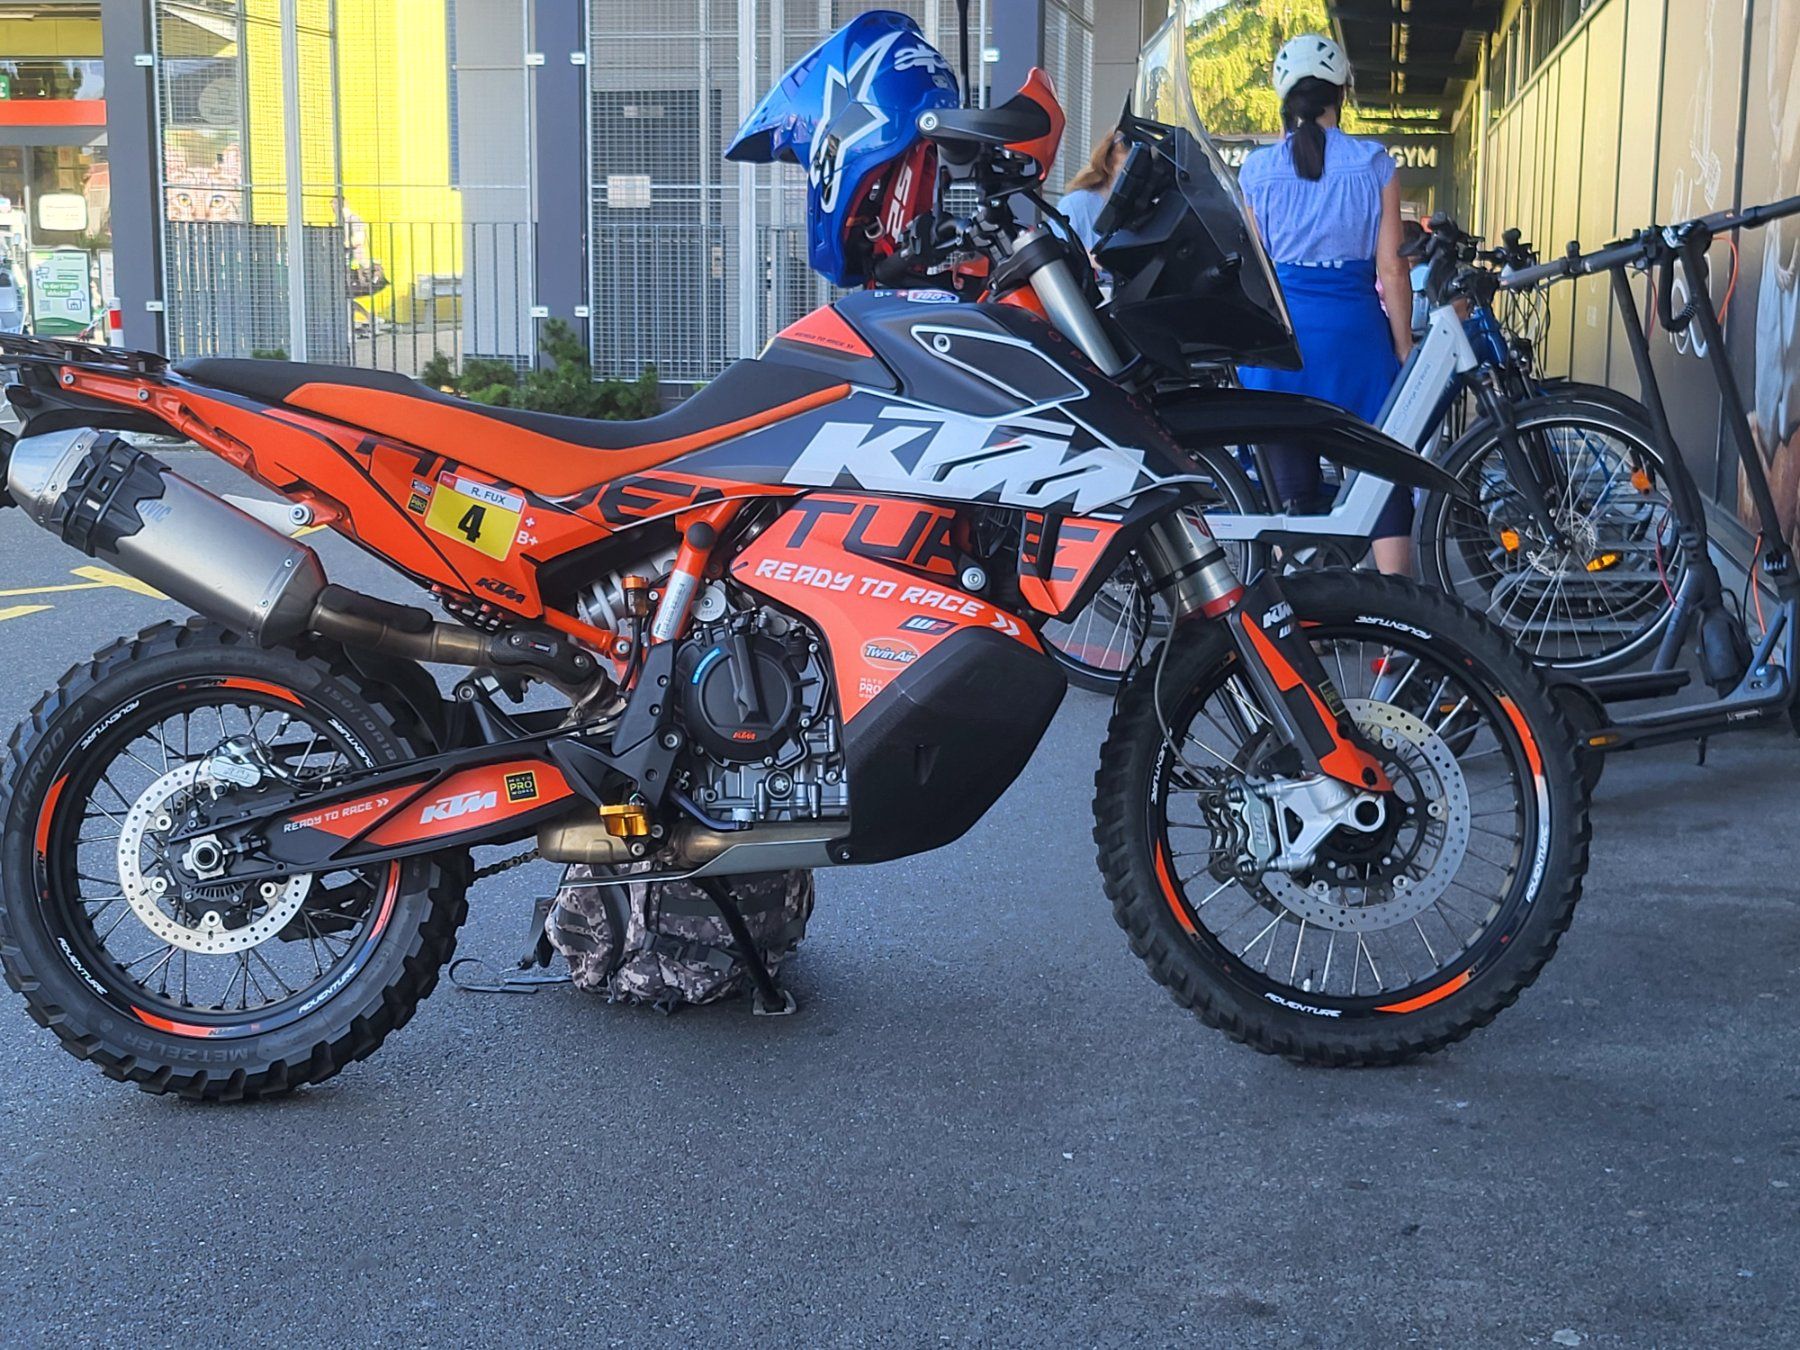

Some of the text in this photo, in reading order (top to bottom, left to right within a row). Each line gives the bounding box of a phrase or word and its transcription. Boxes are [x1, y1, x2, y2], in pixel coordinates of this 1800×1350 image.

[1388, 145, 1438, 168] GYM
[782, 406, 1146, 514] KTM
[471, 486, 507, 505] R. FUX
[457, 504, 487, 543] 4
[516, 530, 538, 546] B+
[476, 577, 526, 604] KTM
[755, 558, 984, 619] READY TO RACE
[1263, 601, 1294, 629] KTM
[1355, 615, 1432, 640] ADVENTURE
[865, 644, 918, 663] Twin Air
[858, 683, 881, 695] PRO
[80, 700, 140, 751] ADVENTURE
[327, 718, 375, 769] DVENTURE
[509, 780, 533, 791] PRO
[283, 802, 373, 833] READY TO RACE
[419, 790, 498, 824] KTM
[1525, 825, 1550, 903] ADVENTURE
[57, 937, 108, 995] ADVENTURE
[298, 963, 358, 1015] ADVENTURE
[1264, 992, 1342, 1018] ADVENTURE
[123, 1032, 249, 1063] METZELER
